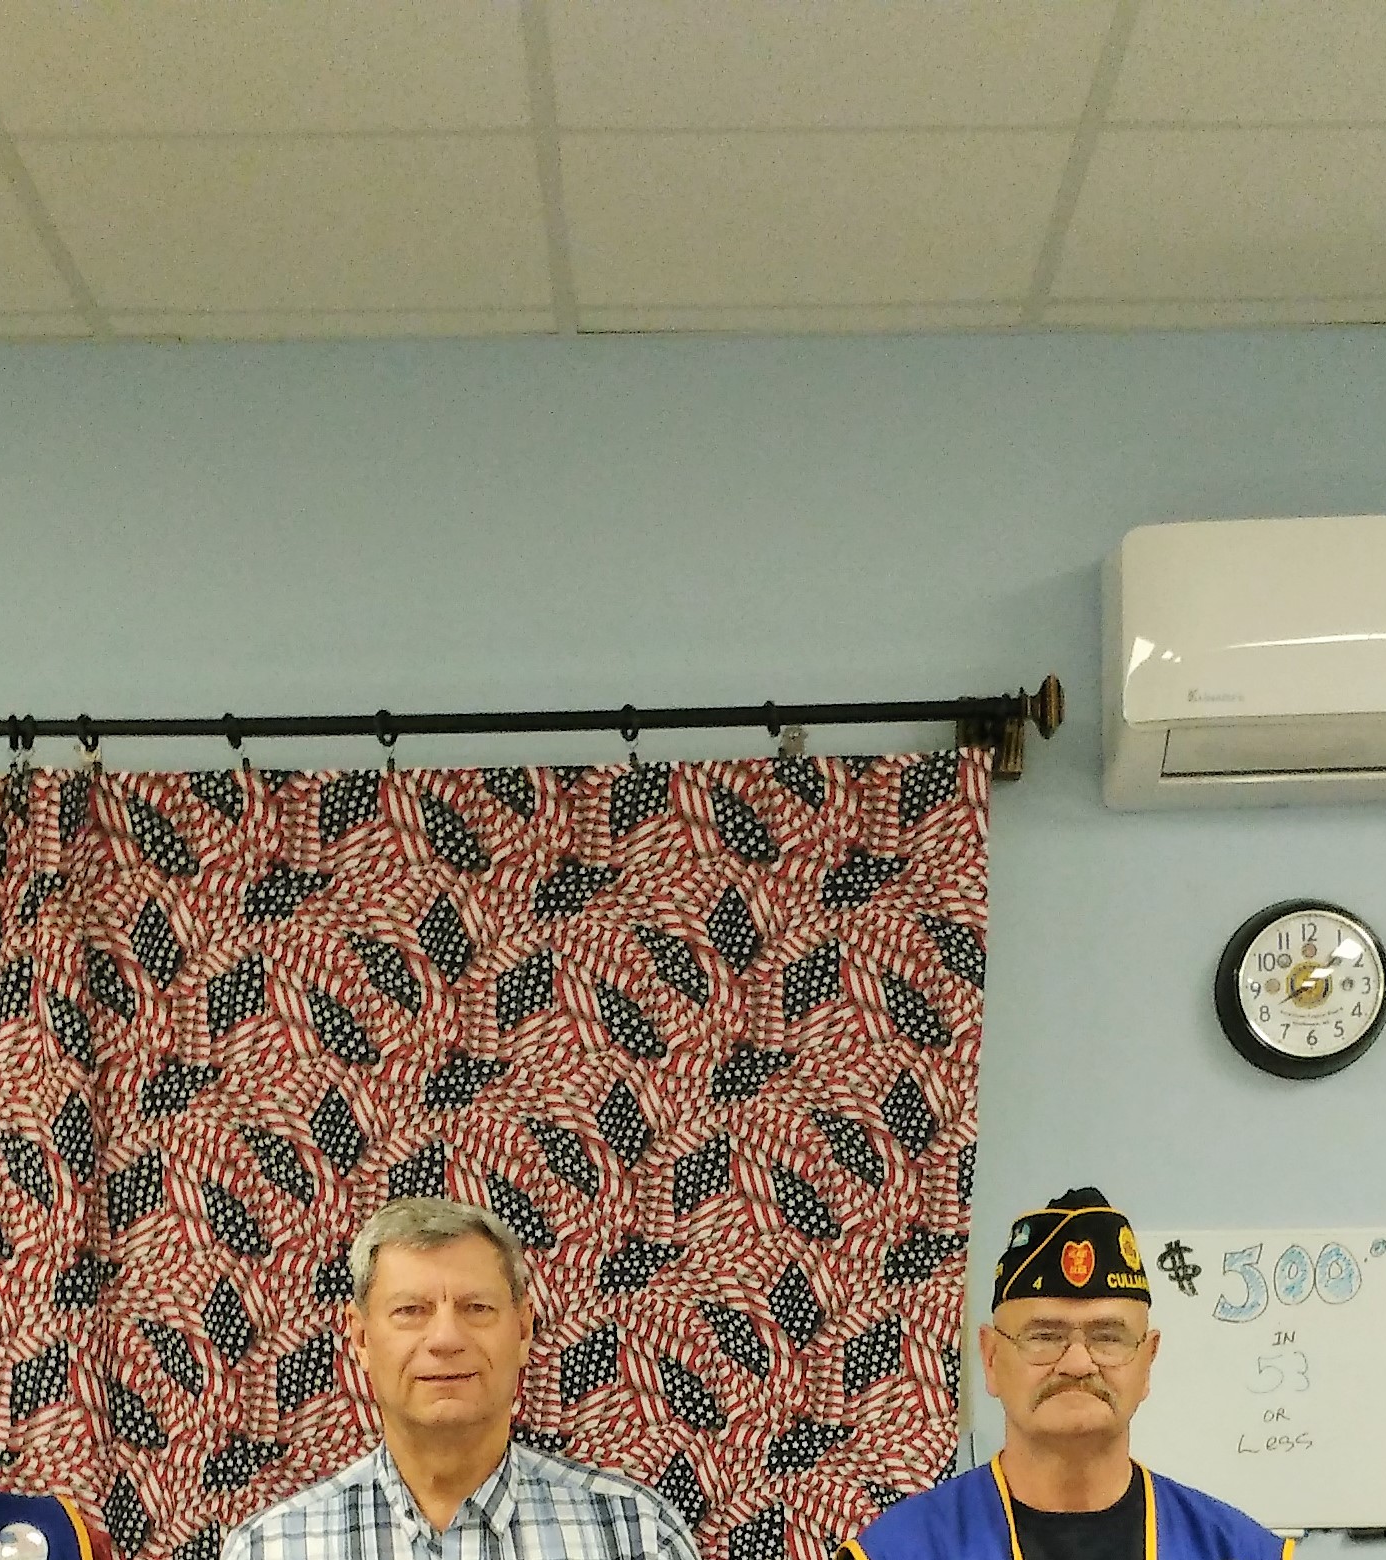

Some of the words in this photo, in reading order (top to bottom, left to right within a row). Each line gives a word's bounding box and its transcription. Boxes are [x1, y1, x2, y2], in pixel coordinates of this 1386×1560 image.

[1278, 931, 1290, 951] 11
[1301, 922, 1318, 942] 12
[1258, 952, 1276, 972] 10
[1249, 981, 1262, 1000] 9
[1361, 976, 1371, 995] 3
[1259, 1004, 1271, 1022] 8
[1351, 1001, 1363, 1018] 4
[1280, 1023, 1291, 1039] 7
[1306, 1029, 1318, 1046] 6
[1333, 1020, 1344, 1038] 5
[1032, 1276, 1043, 1290] 4
[1271, 1331, 1297, 1347] IN
[1246, 1351, 1311, 1394] 53
[1263, 1407, 1291, 1423] OR
